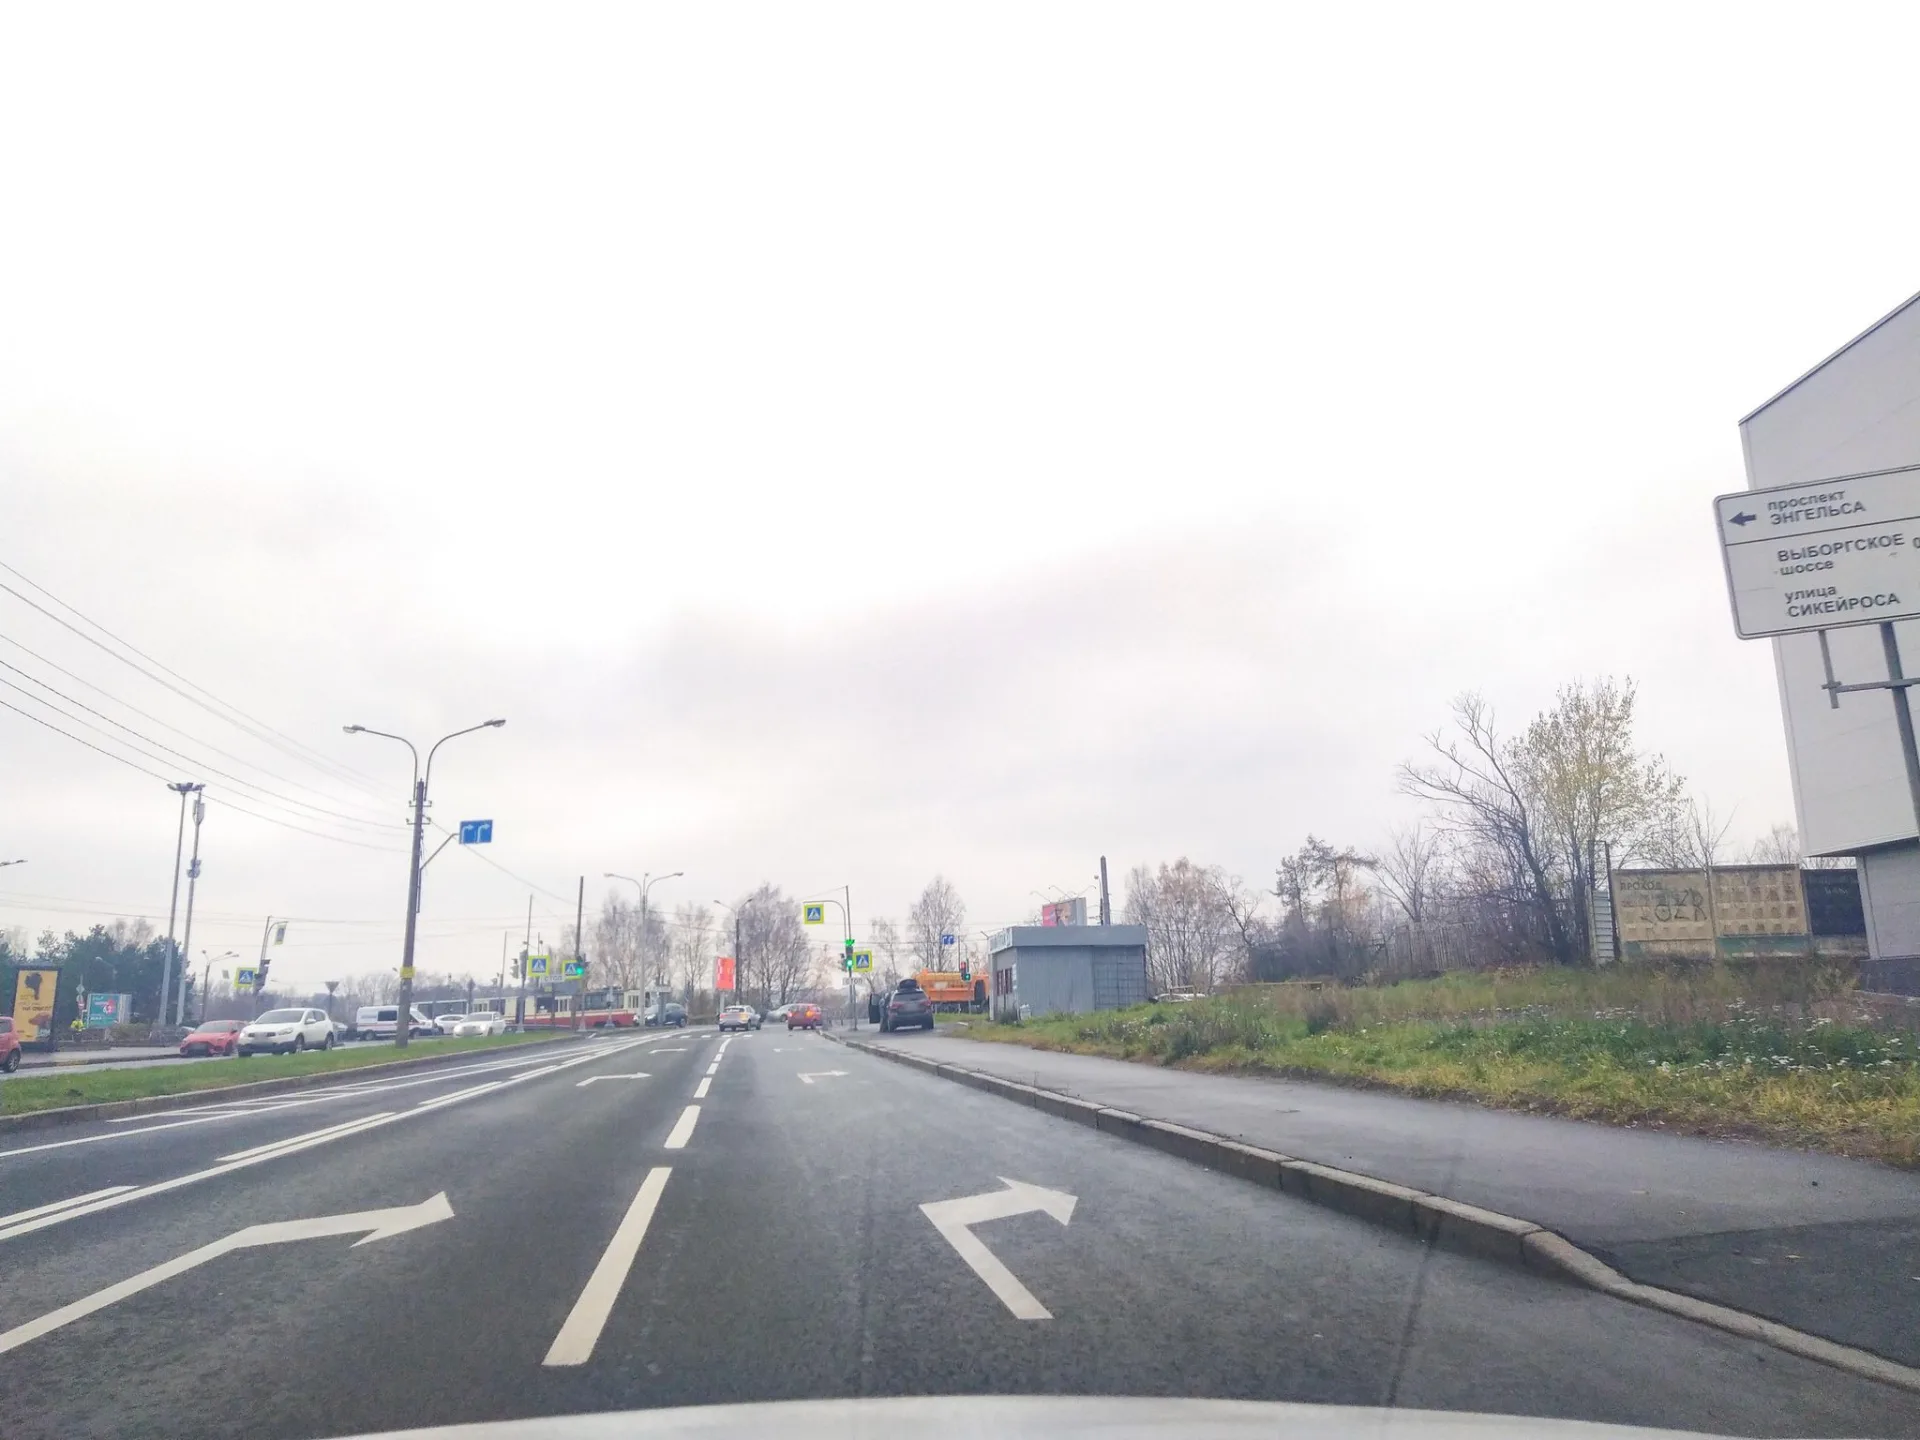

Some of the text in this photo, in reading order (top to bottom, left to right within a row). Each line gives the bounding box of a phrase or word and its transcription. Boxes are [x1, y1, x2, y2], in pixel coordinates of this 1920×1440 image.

[1767, 490, 1845, 511] проспект
[1770, 501, 1866, 525] ЭНГЕЛЬСА
[1777, 533, 1905, 562] ВЫБОРГСКОЕ
[1780, 561, 1834, 576] шоссе
[1785, 586, 1837, 604] улица
[1787, 593, 1900, 618] СИКЕЙРОСА
